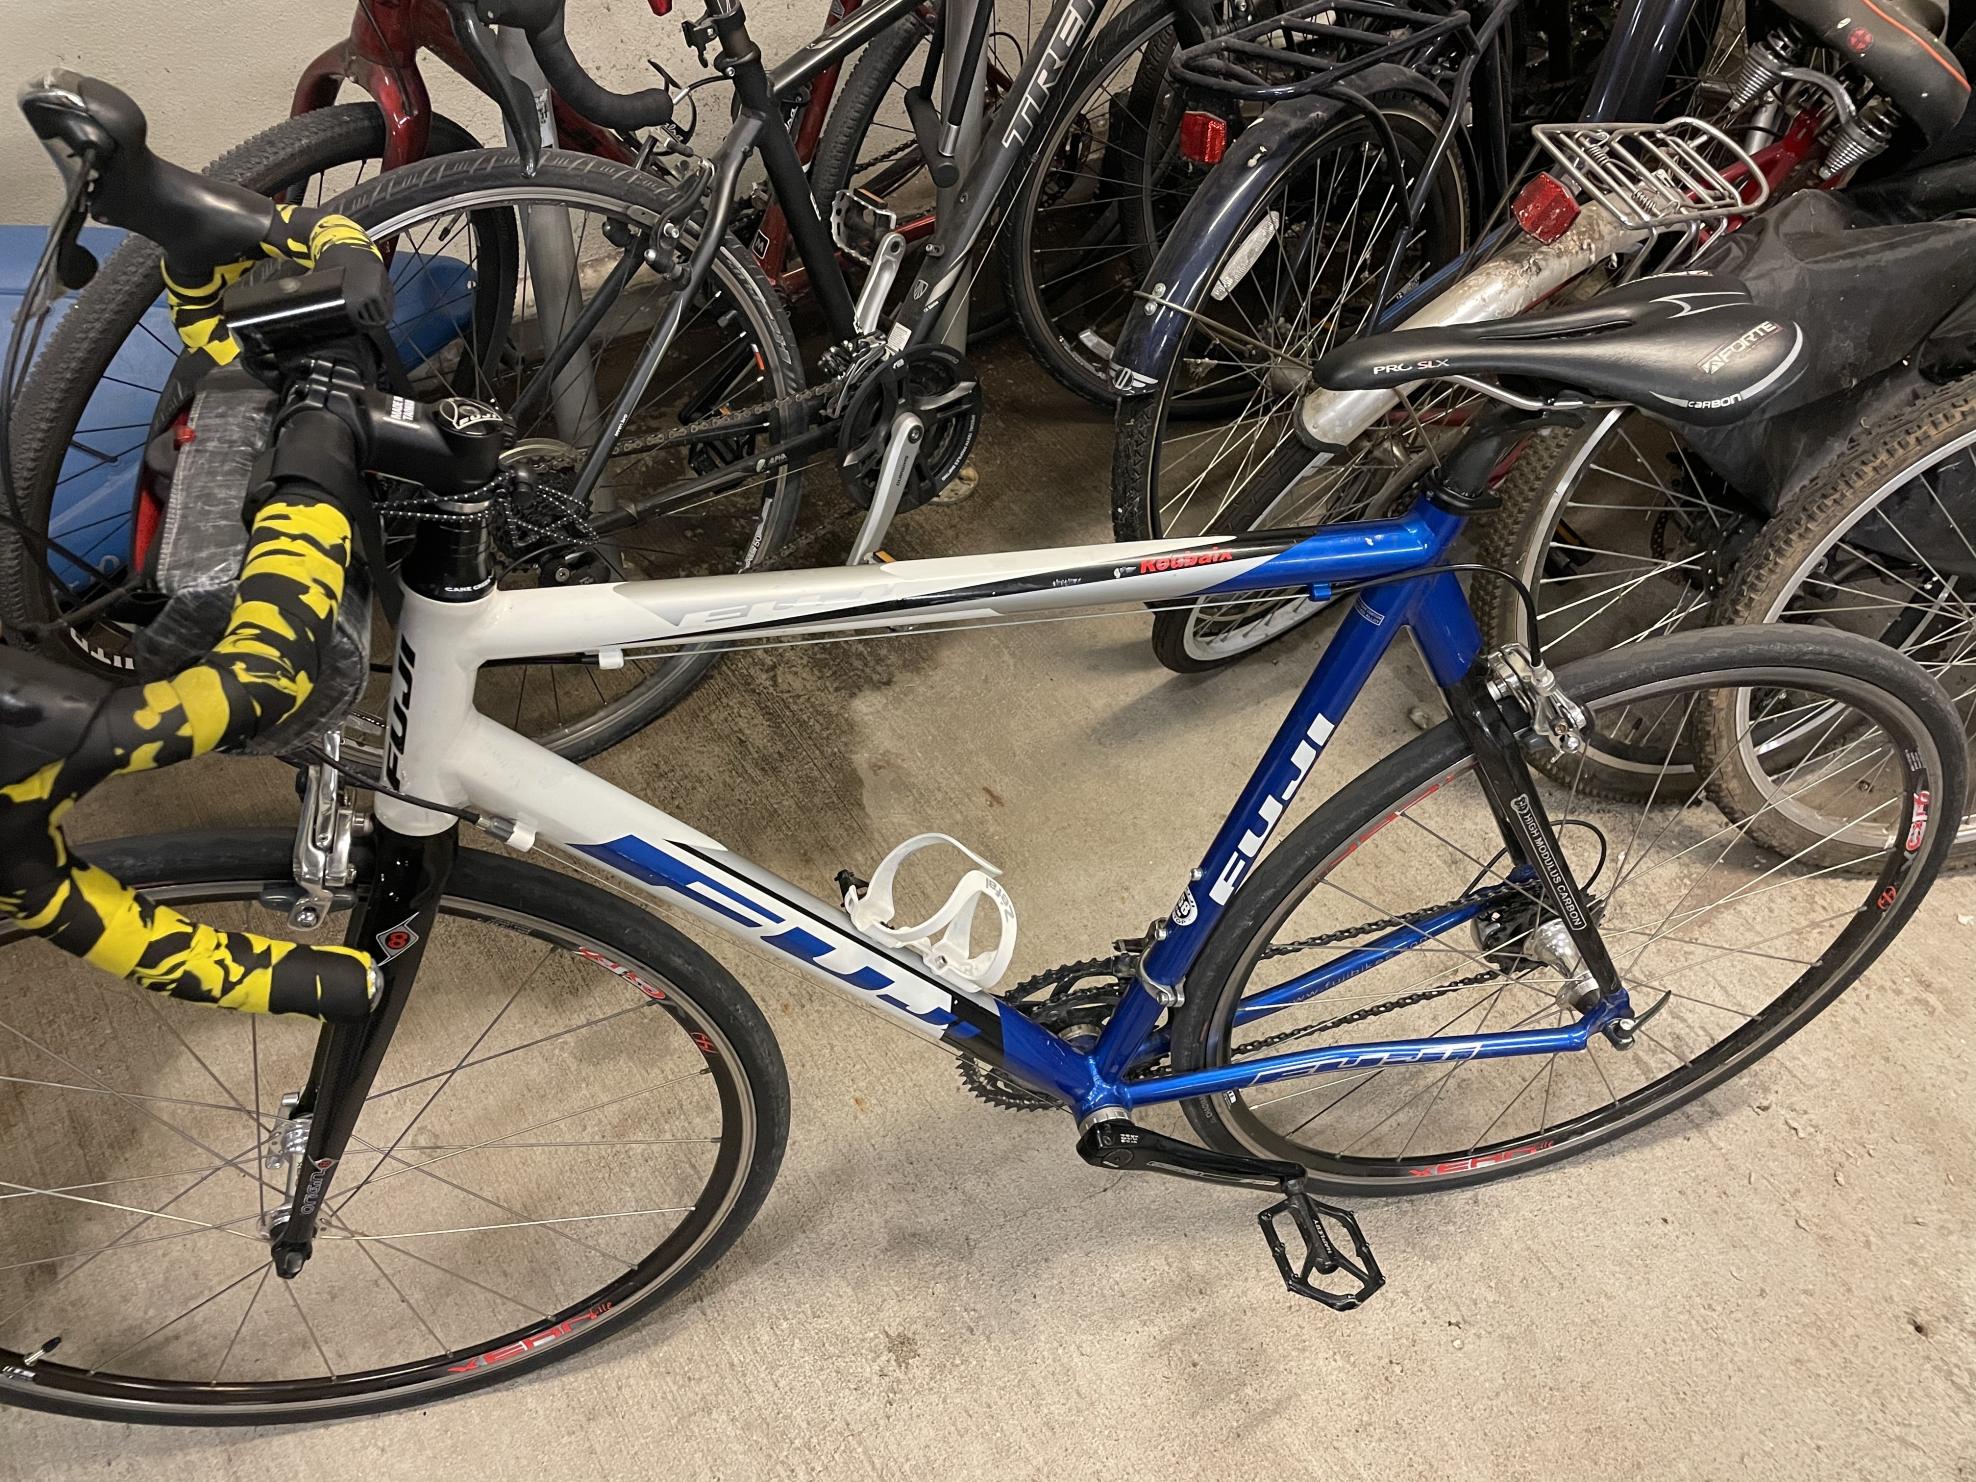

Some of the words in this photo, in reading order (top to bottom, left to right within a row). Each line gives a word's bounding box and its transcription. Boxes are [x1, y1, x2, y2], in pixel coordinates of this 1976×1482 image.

[1417, 359, 1450, 370] SLX
[386, 634, 416, 792] FUJI
[1209, 712, 1335, 906] FUJI
[1523, 814, 1540, 838] HIGH
[1534, 836, 1562, 884] MODULUS
[1557, 884, 1583, 926] CARBON
